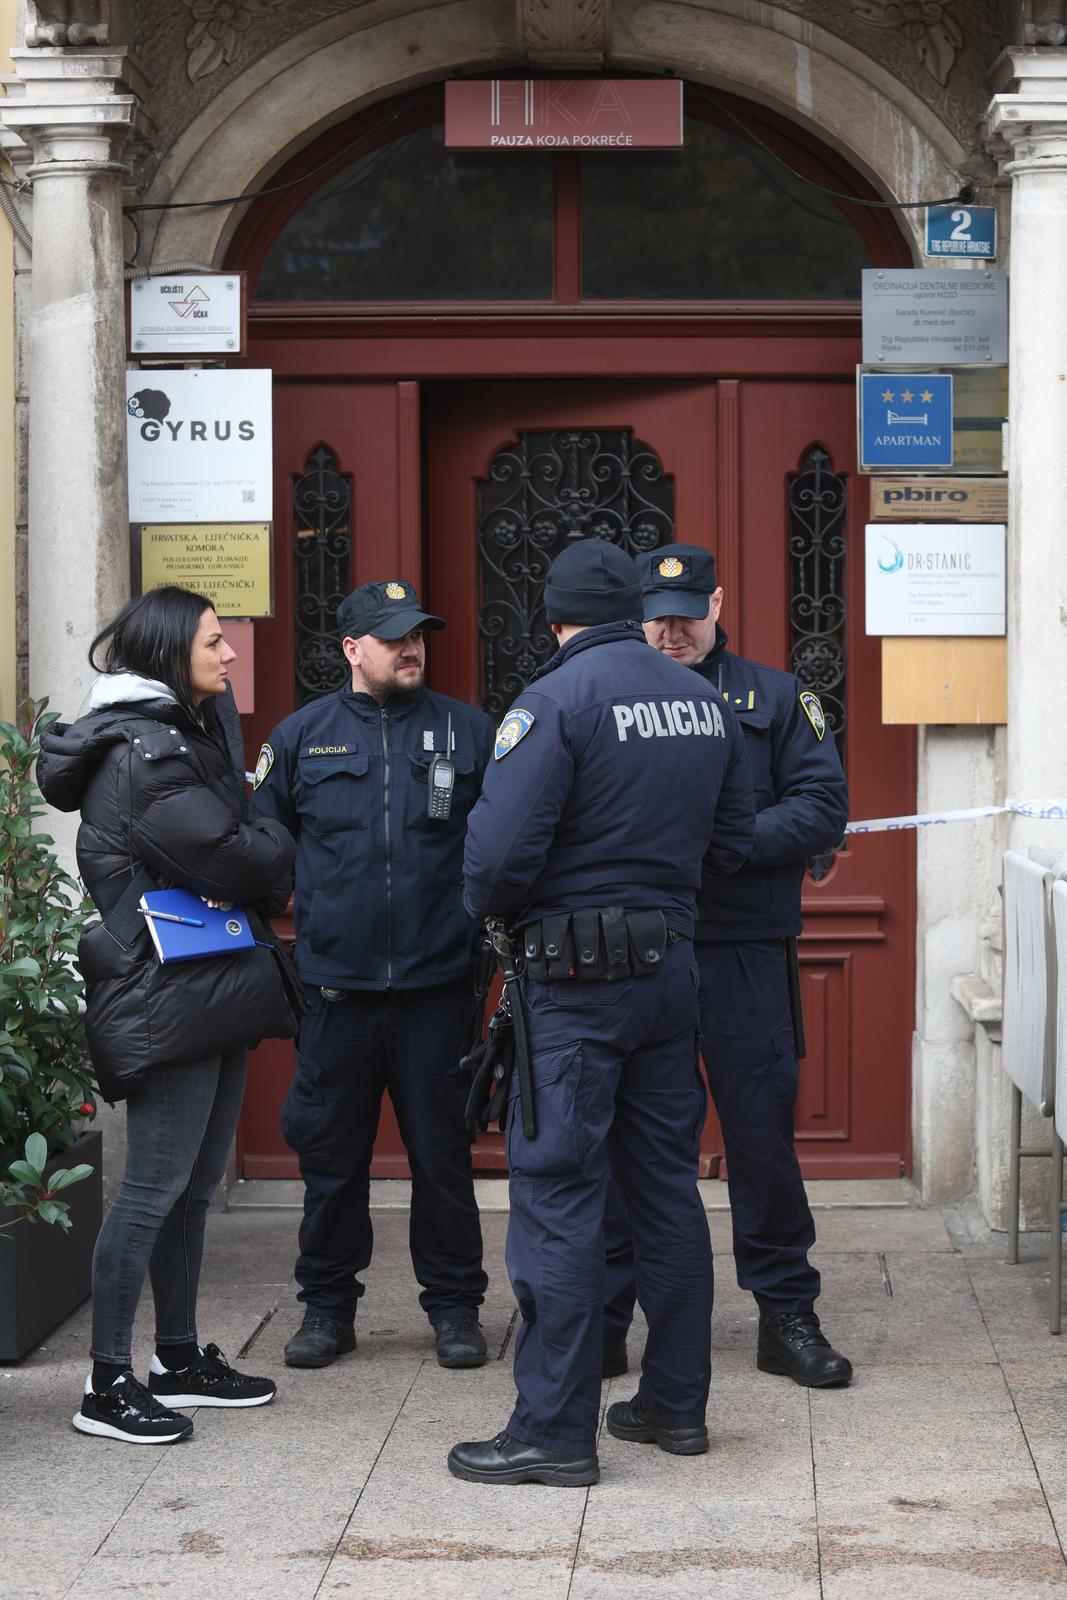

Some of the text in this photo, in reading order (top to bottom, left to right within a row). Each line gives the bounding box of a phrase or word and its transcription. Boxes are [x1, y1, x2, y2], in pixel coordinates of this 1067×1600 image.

[490, 132, 633, 147] PAUZA KOJA POKREĆE
[951, 209, 971, 240] 2
[160, 285, 184, 294] UČILIŠTE
[873, 282, 996, 290] ORDINACIJA DENTALNE MEDICINE
[193, 310, 208, 318] UČKA
[140, 420, 255, 441] GYRUS
[874, 435, 942, 446] APARTMAN
[883, 487, 969, 504] pbiro
[151, 531, 260, 542] HRVATSKA LIJEČNIČKA
[186, 544, 225, 552] KOMORA
[203, 579, 255, 589] LIJEČNIČKI
[612, 700, 726, 742] POLICIJA
[309, 745, 347, 755] POLICIJA
